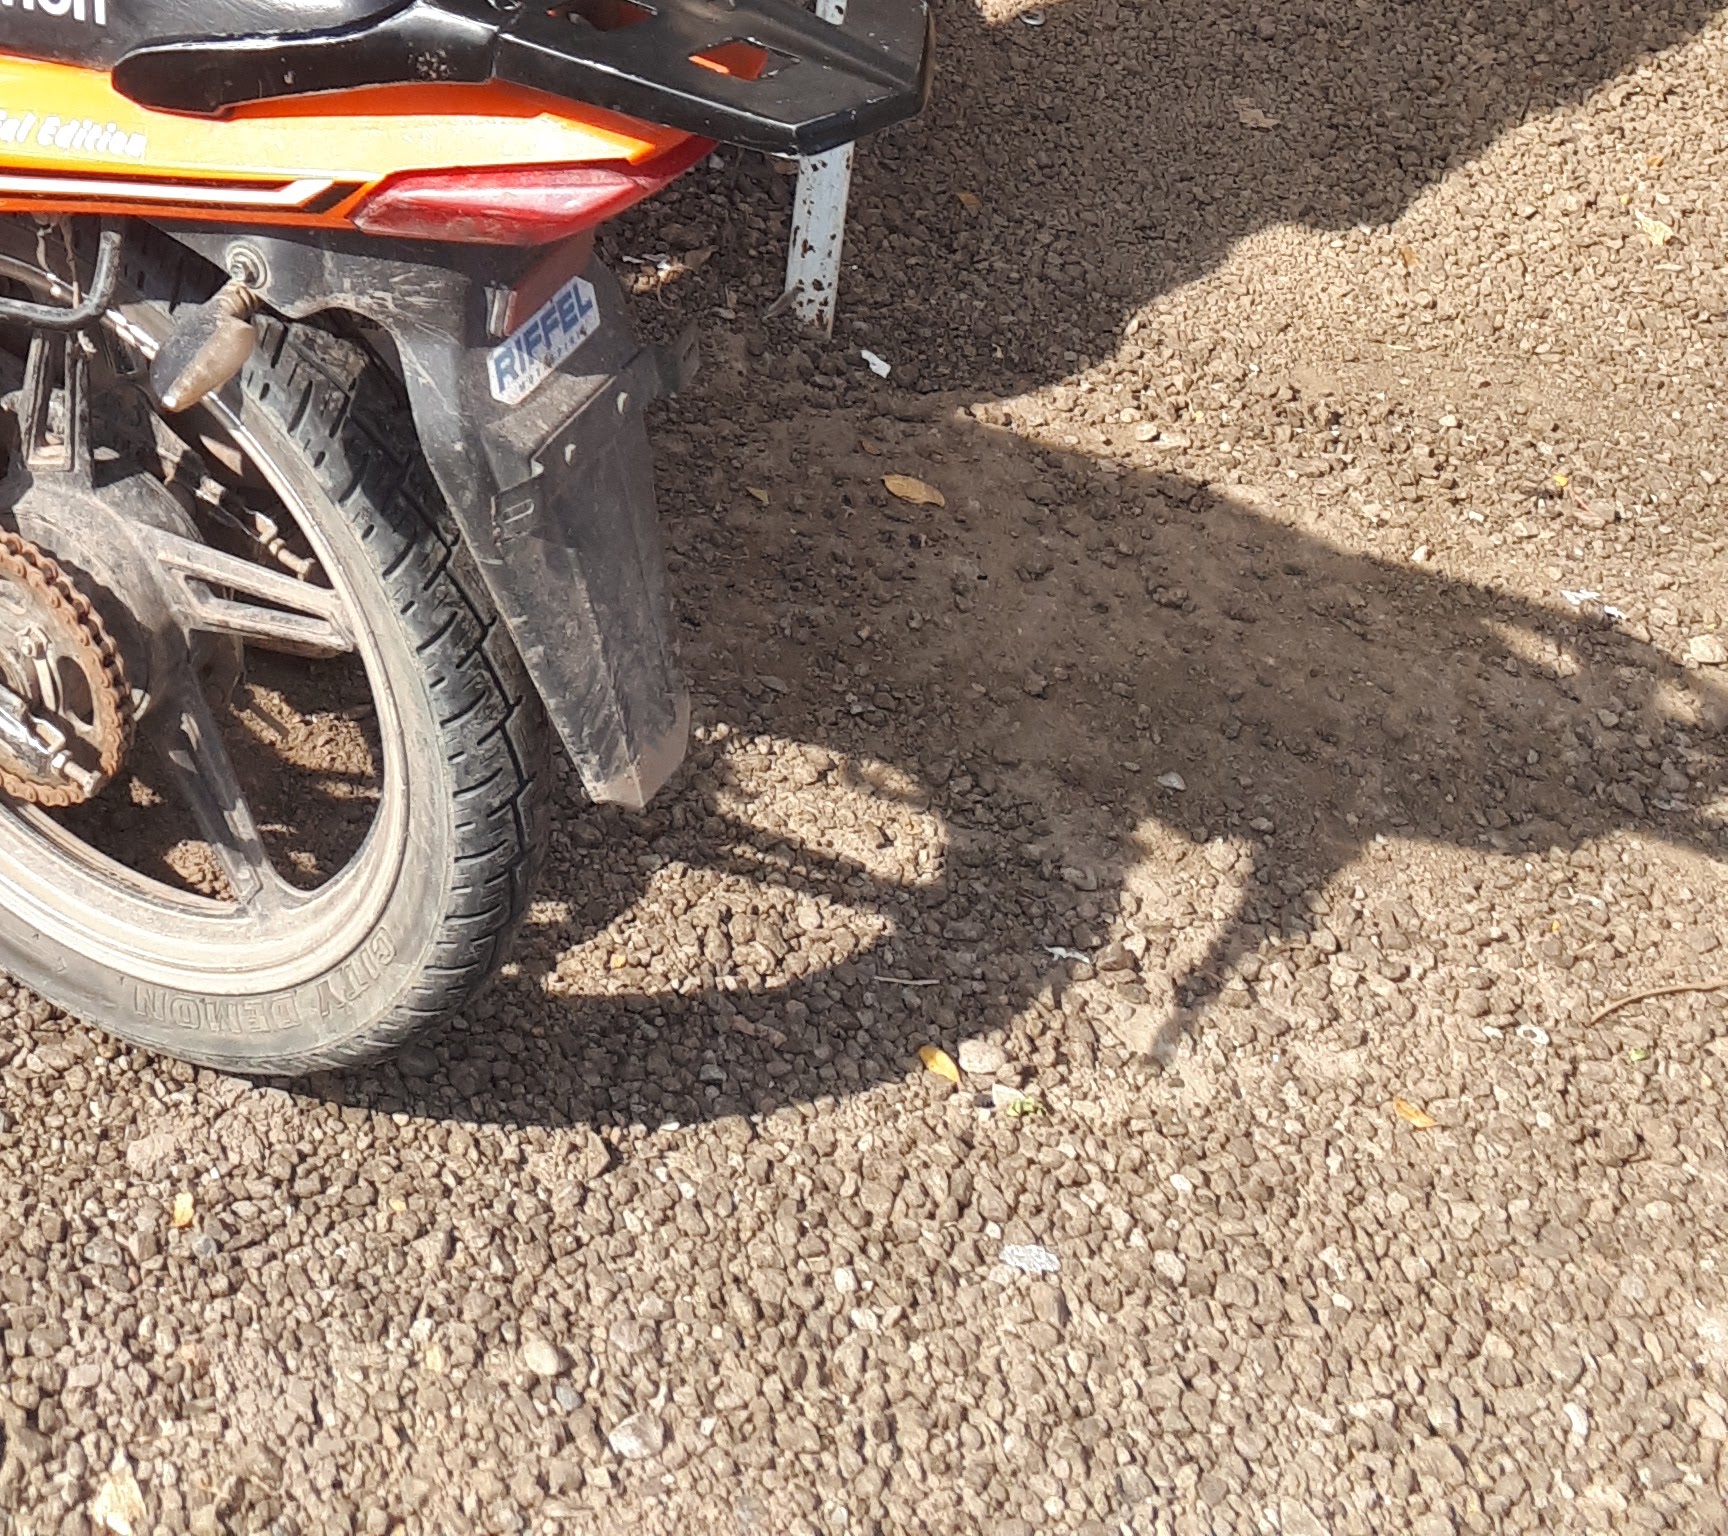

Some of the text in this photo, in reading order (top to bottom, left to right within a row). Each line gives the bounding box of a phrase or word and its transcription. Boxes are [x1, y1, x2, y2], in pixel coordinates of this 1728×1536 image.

[37, 115, 148, 166] Edition
[493, 282, 594, 395] RIFFEL
[132, 926, 397, 1034] CITY DEMON
